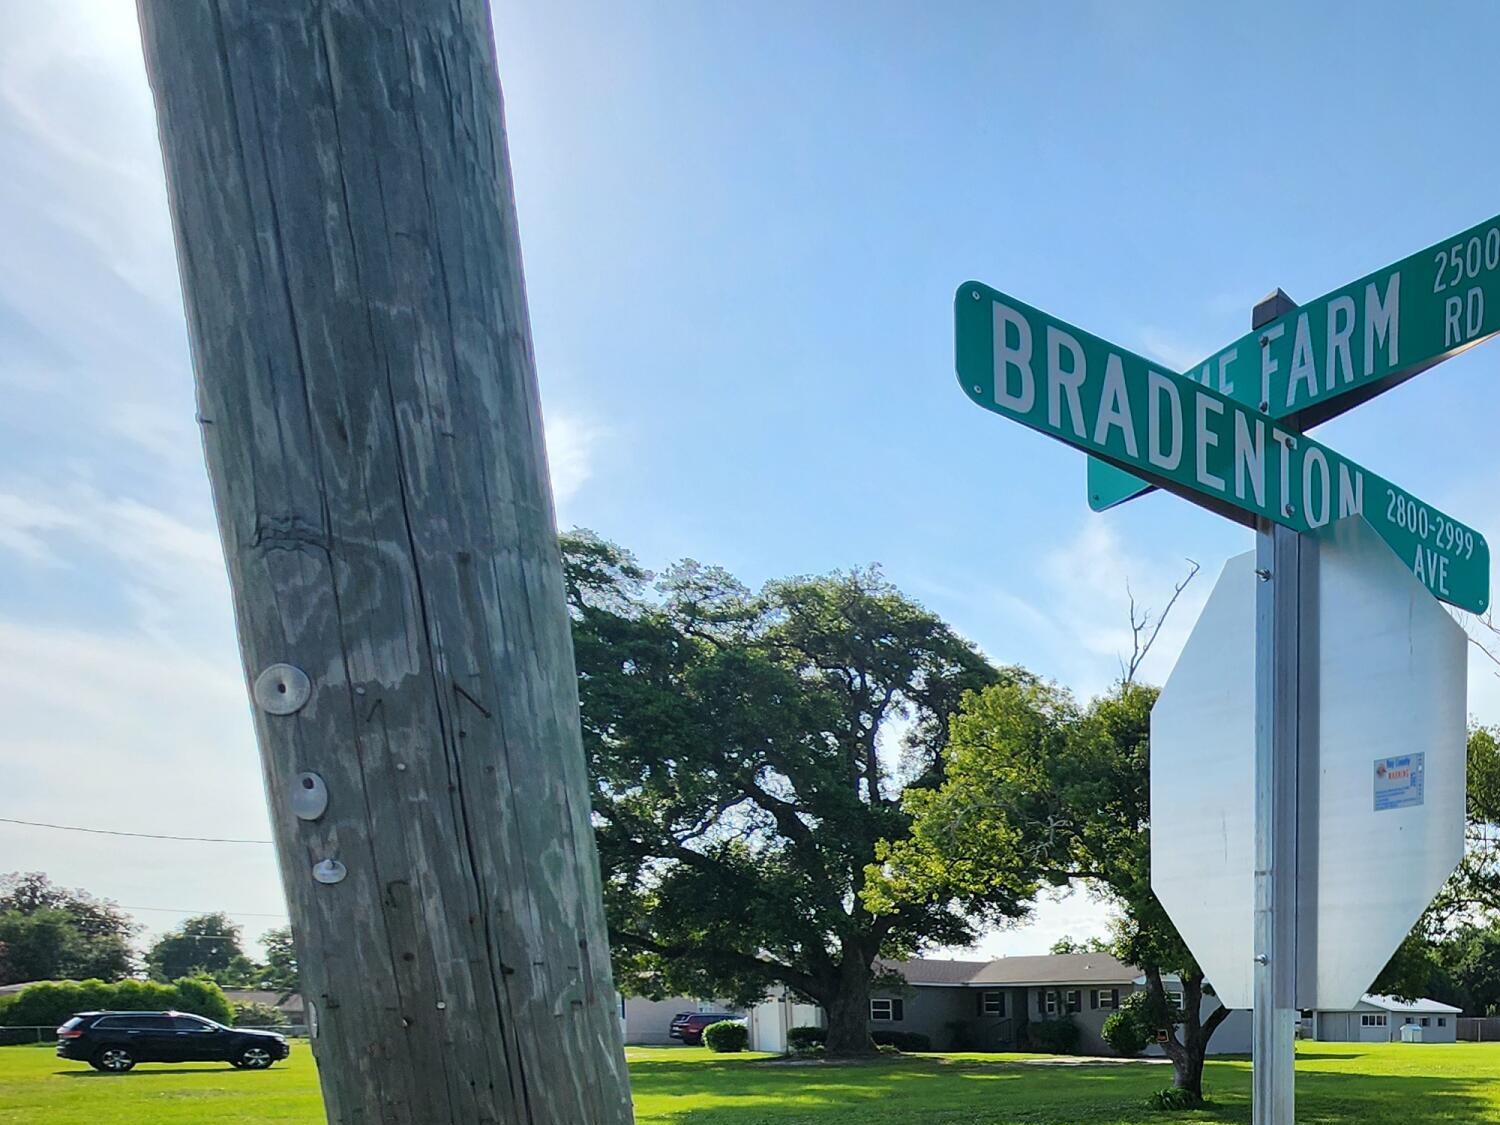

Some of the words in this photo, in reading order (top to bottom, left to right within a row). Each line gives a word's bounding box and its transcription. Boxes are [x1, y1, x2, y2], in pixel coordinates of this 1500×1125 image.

[1433, 227, 1500, 293] 2500
[1260, 271, 1402, 416] FARM
[1444, 286, 1485, 347] RD
[992, 300, 1364, 529] BRADENTON
[1413, 543, 1450, 596] AVE
[1386, 488, 1474, 560] 2800-2999
